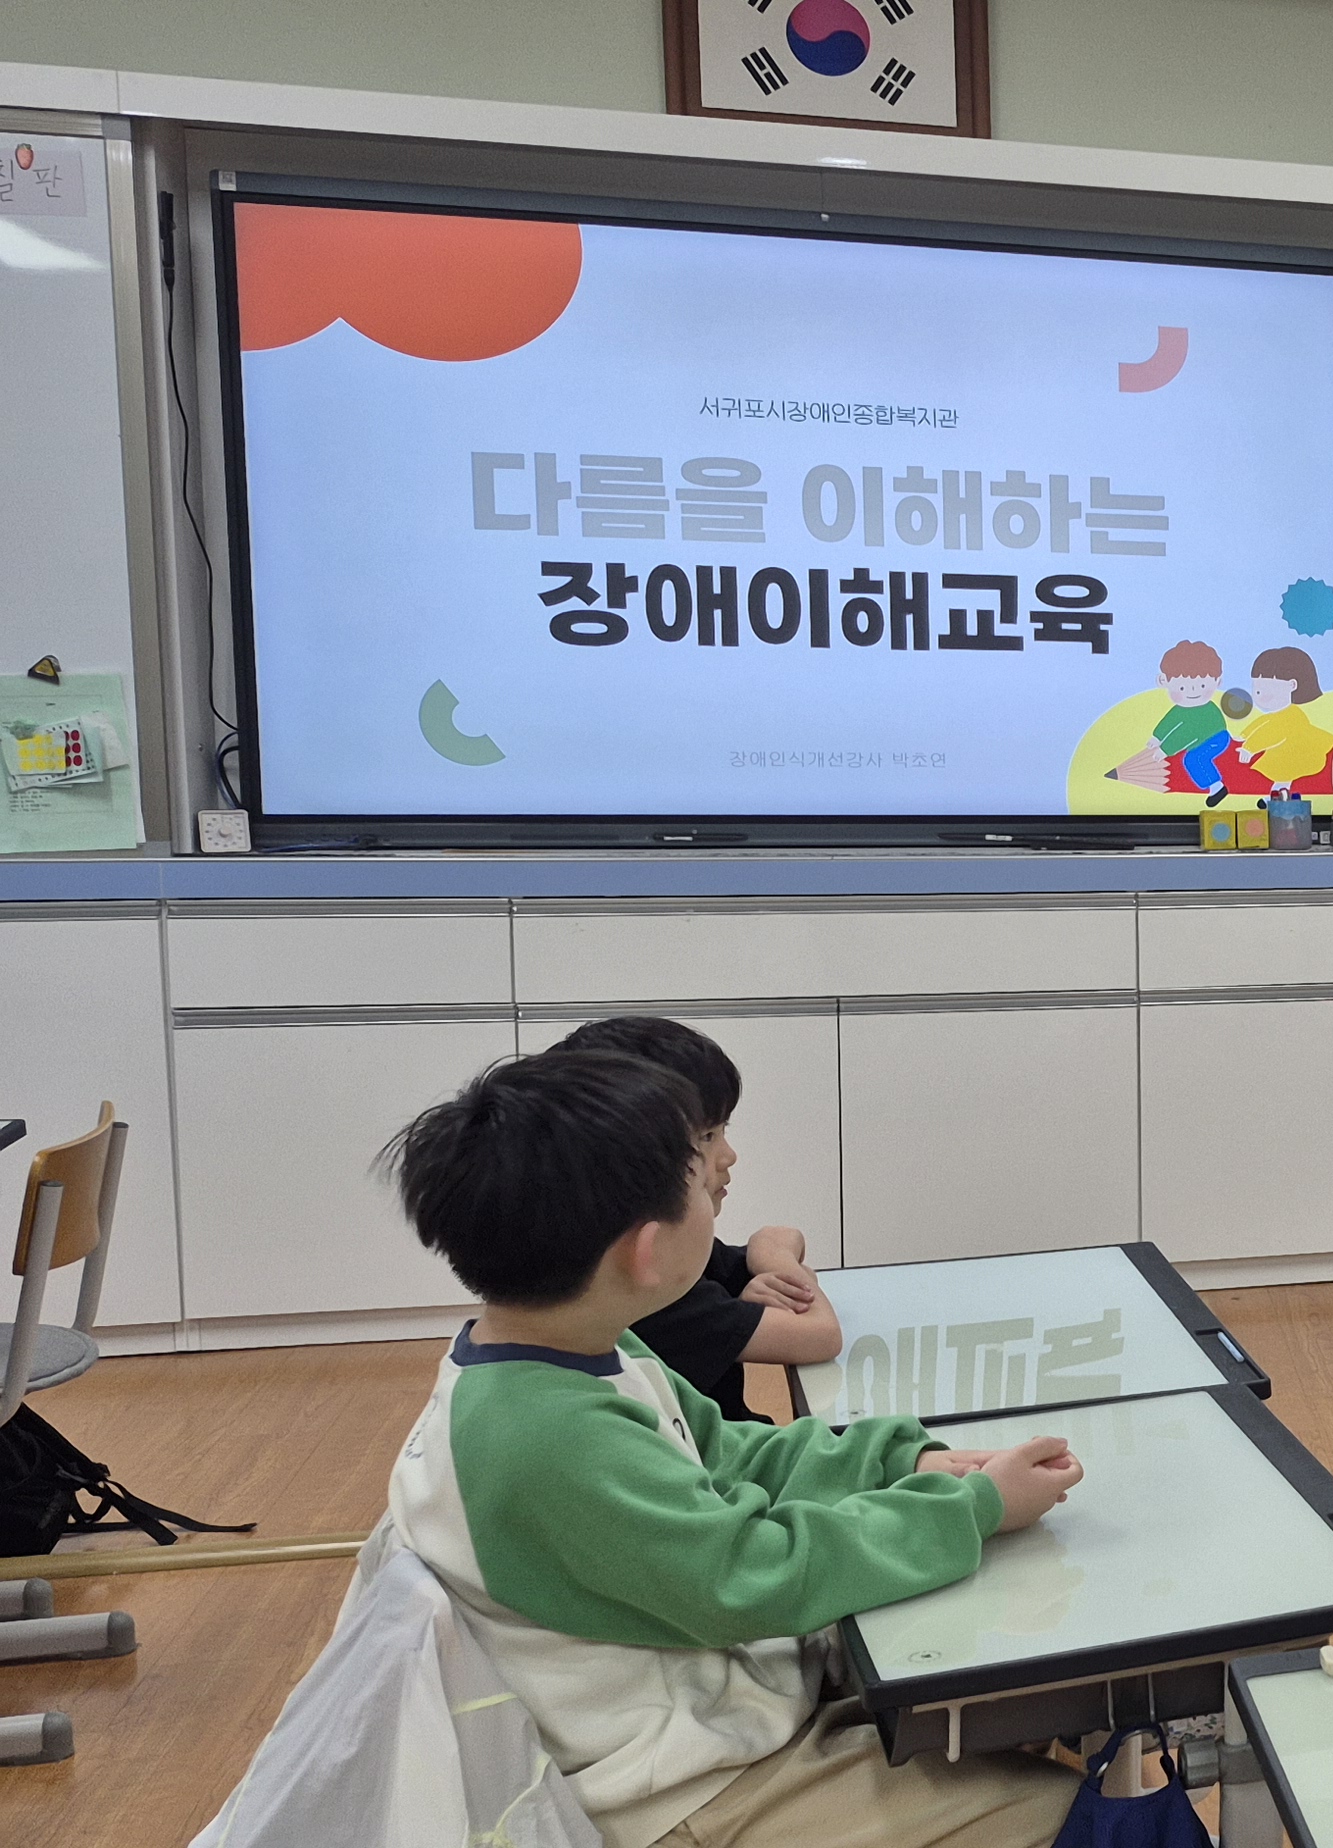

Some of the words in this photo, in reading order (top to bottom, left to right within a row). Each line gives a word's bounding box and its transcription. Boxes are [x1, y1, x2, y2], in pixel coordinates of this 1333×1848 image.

[700, 397, 958, 428] 서귀포시장애인종합복지관
[470, 451, 768, 543] 다름을
[802, 464, 1169, 557] 이해하는
[538, 561, 1113, 654] 장애이해교육
[730, 751, 882, 768] 장애인식개선강사
[892, 752, 946, 768] 박초연
